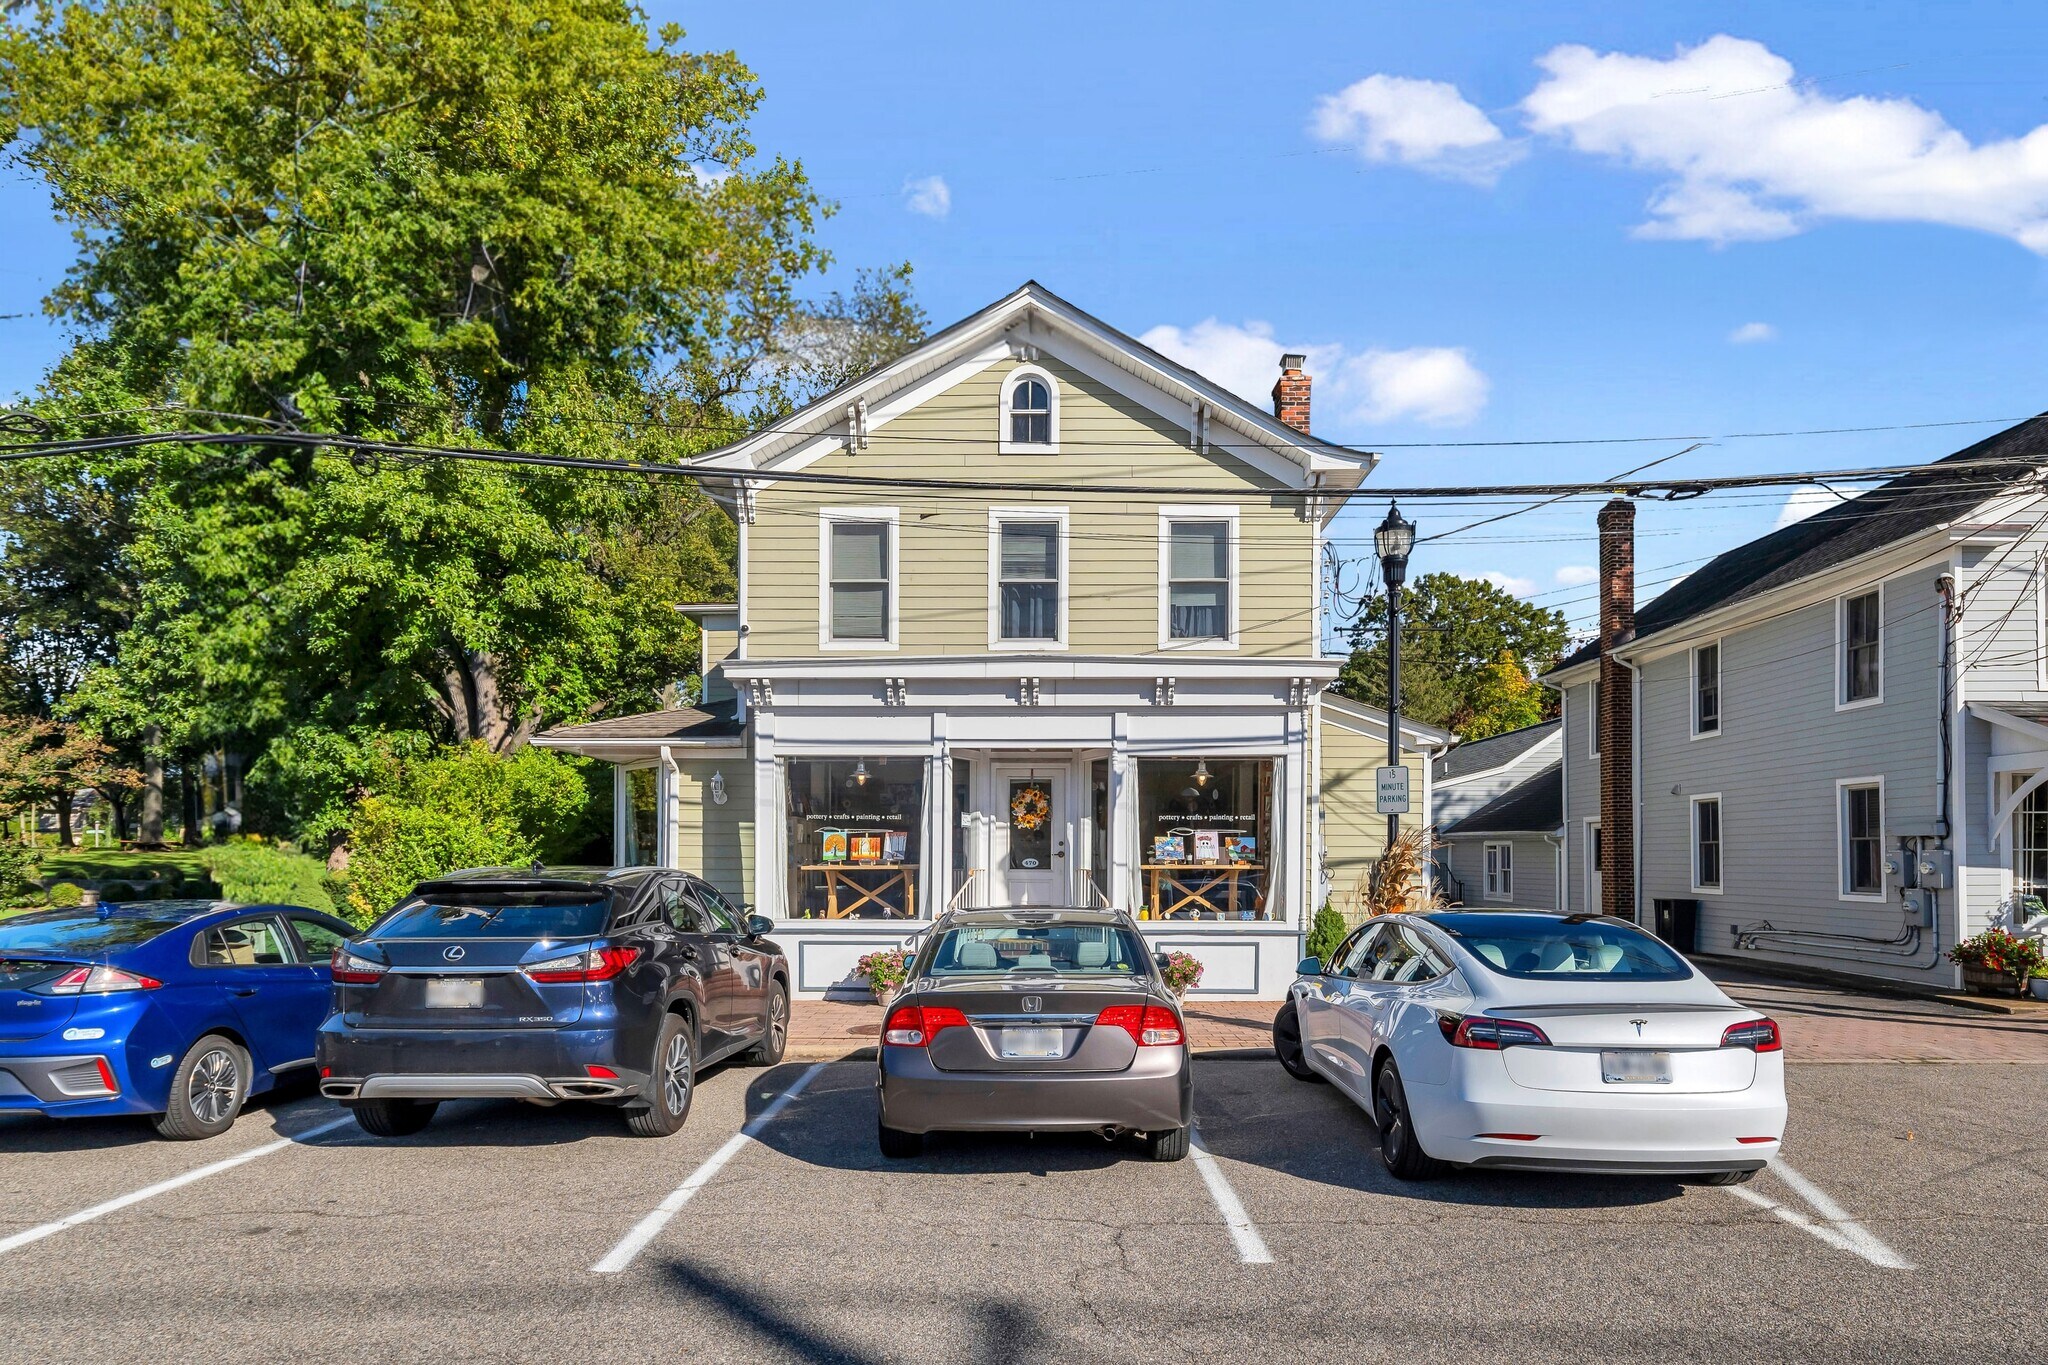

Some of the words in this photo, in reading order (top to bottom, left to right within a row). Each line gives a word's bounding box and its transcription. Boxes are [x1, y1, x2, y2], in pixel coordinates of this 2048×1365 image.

[1388, 770, 1396, 778] 15
[856, 813, 880, 822] painting
[1209, 814, 1234, 822] painting
